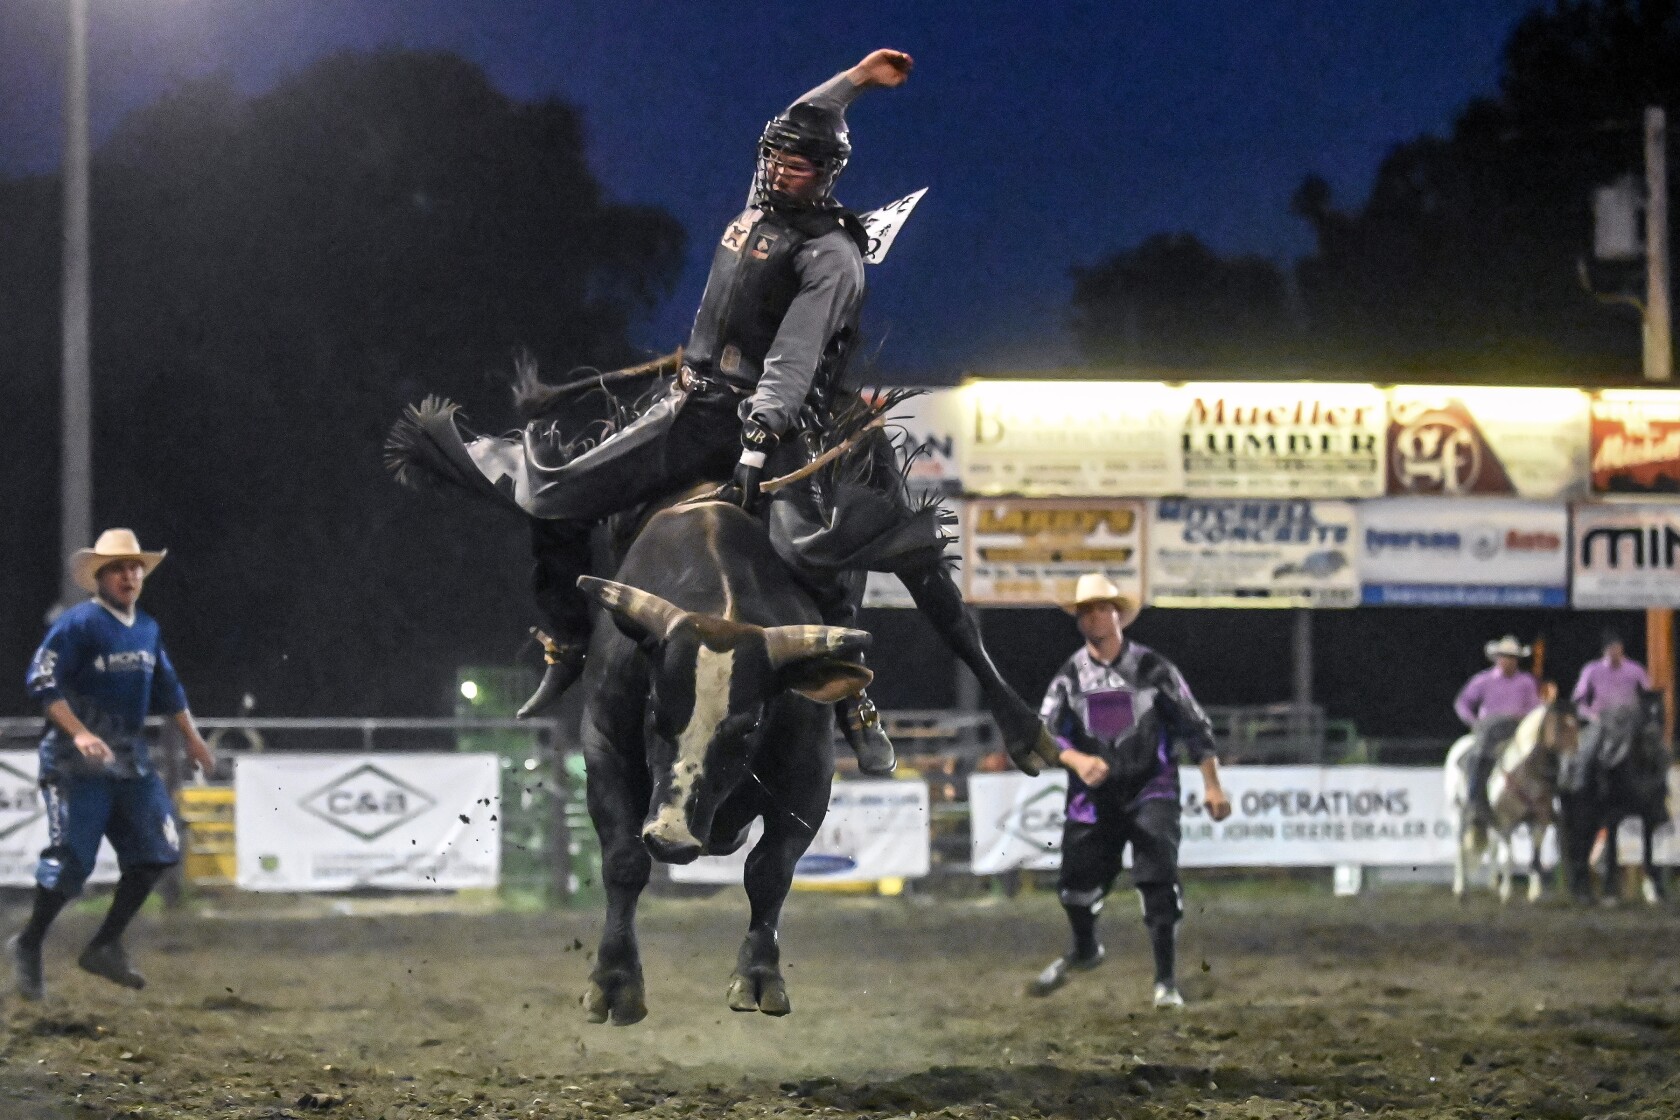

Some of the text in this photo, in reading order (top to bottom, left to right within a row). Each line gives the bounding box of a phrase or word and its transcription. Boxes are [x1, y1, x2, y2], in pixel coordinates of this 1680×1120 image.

[1186, 397, 1374, 427] Mueller
[745, 427, 767, 444] JB
[1182, 433, 1377, 455] LUMBER
[1241, 788, 1410, 817] OPERATIONS
[1224, 821, 1275, 839] JOHN
[1352, 820, 1426, 839] DEALER
